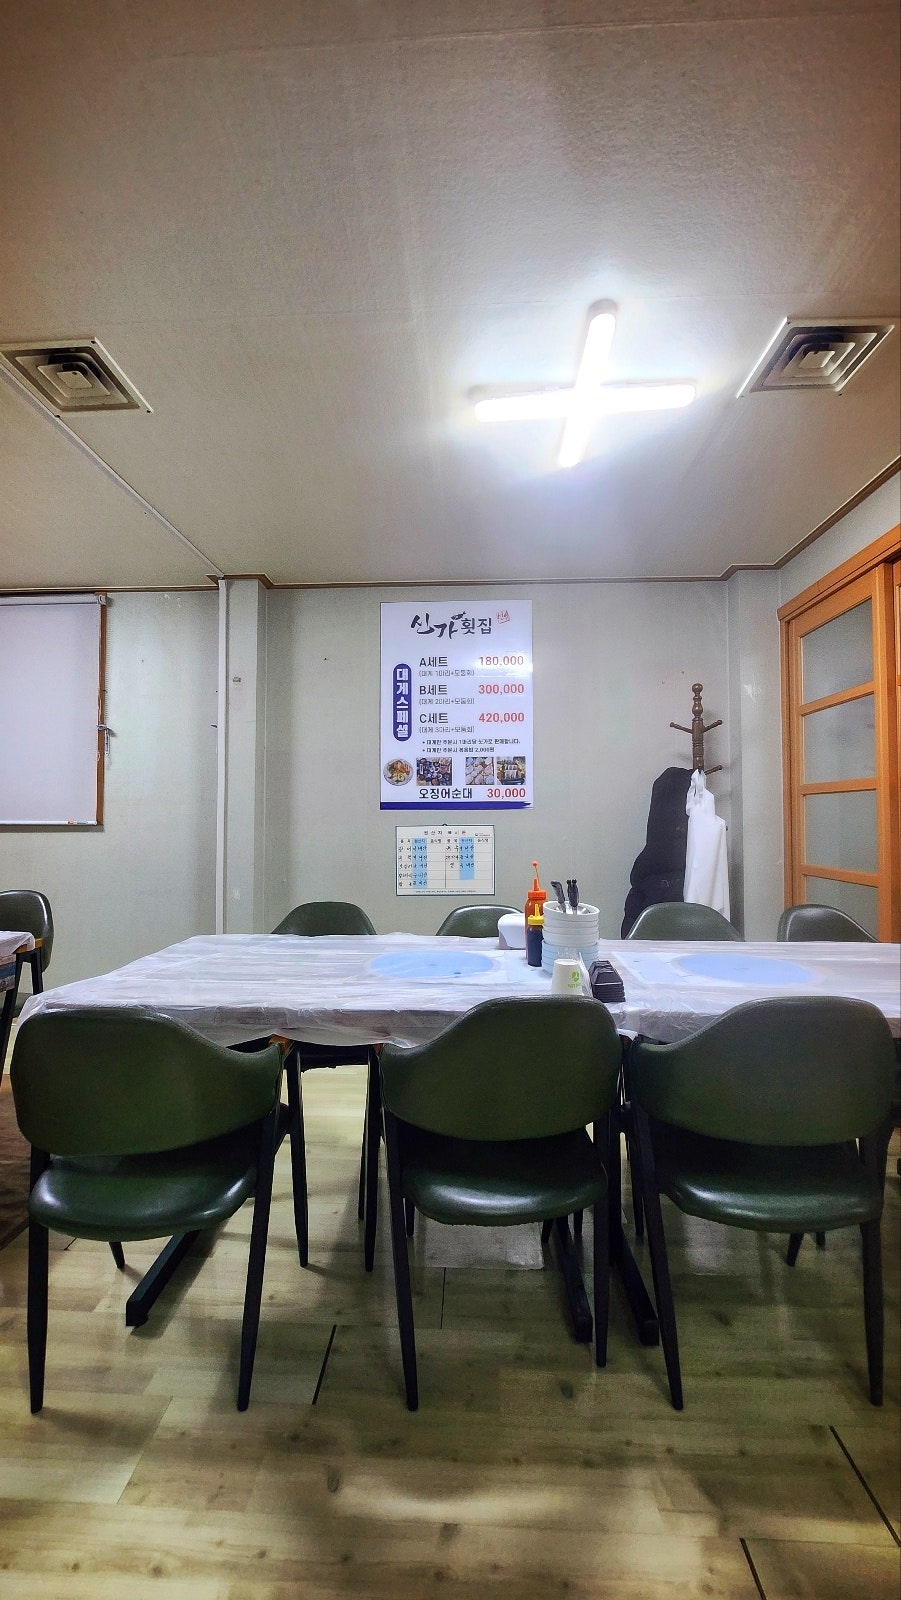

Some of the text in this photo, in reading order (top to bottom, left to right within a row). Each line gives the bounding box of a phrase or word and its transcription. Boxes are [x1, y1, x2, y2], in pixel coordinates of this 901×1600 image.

[411, 613, 492, 639] 신가횟집
[419, 656, 524, 667] A세트 180,000
[419, 684, 525, 696] B세트 300,000
[419, 712, 525, 724] C세트 420,000
[419, 788, 526, 799] 오징어순대 30,000
